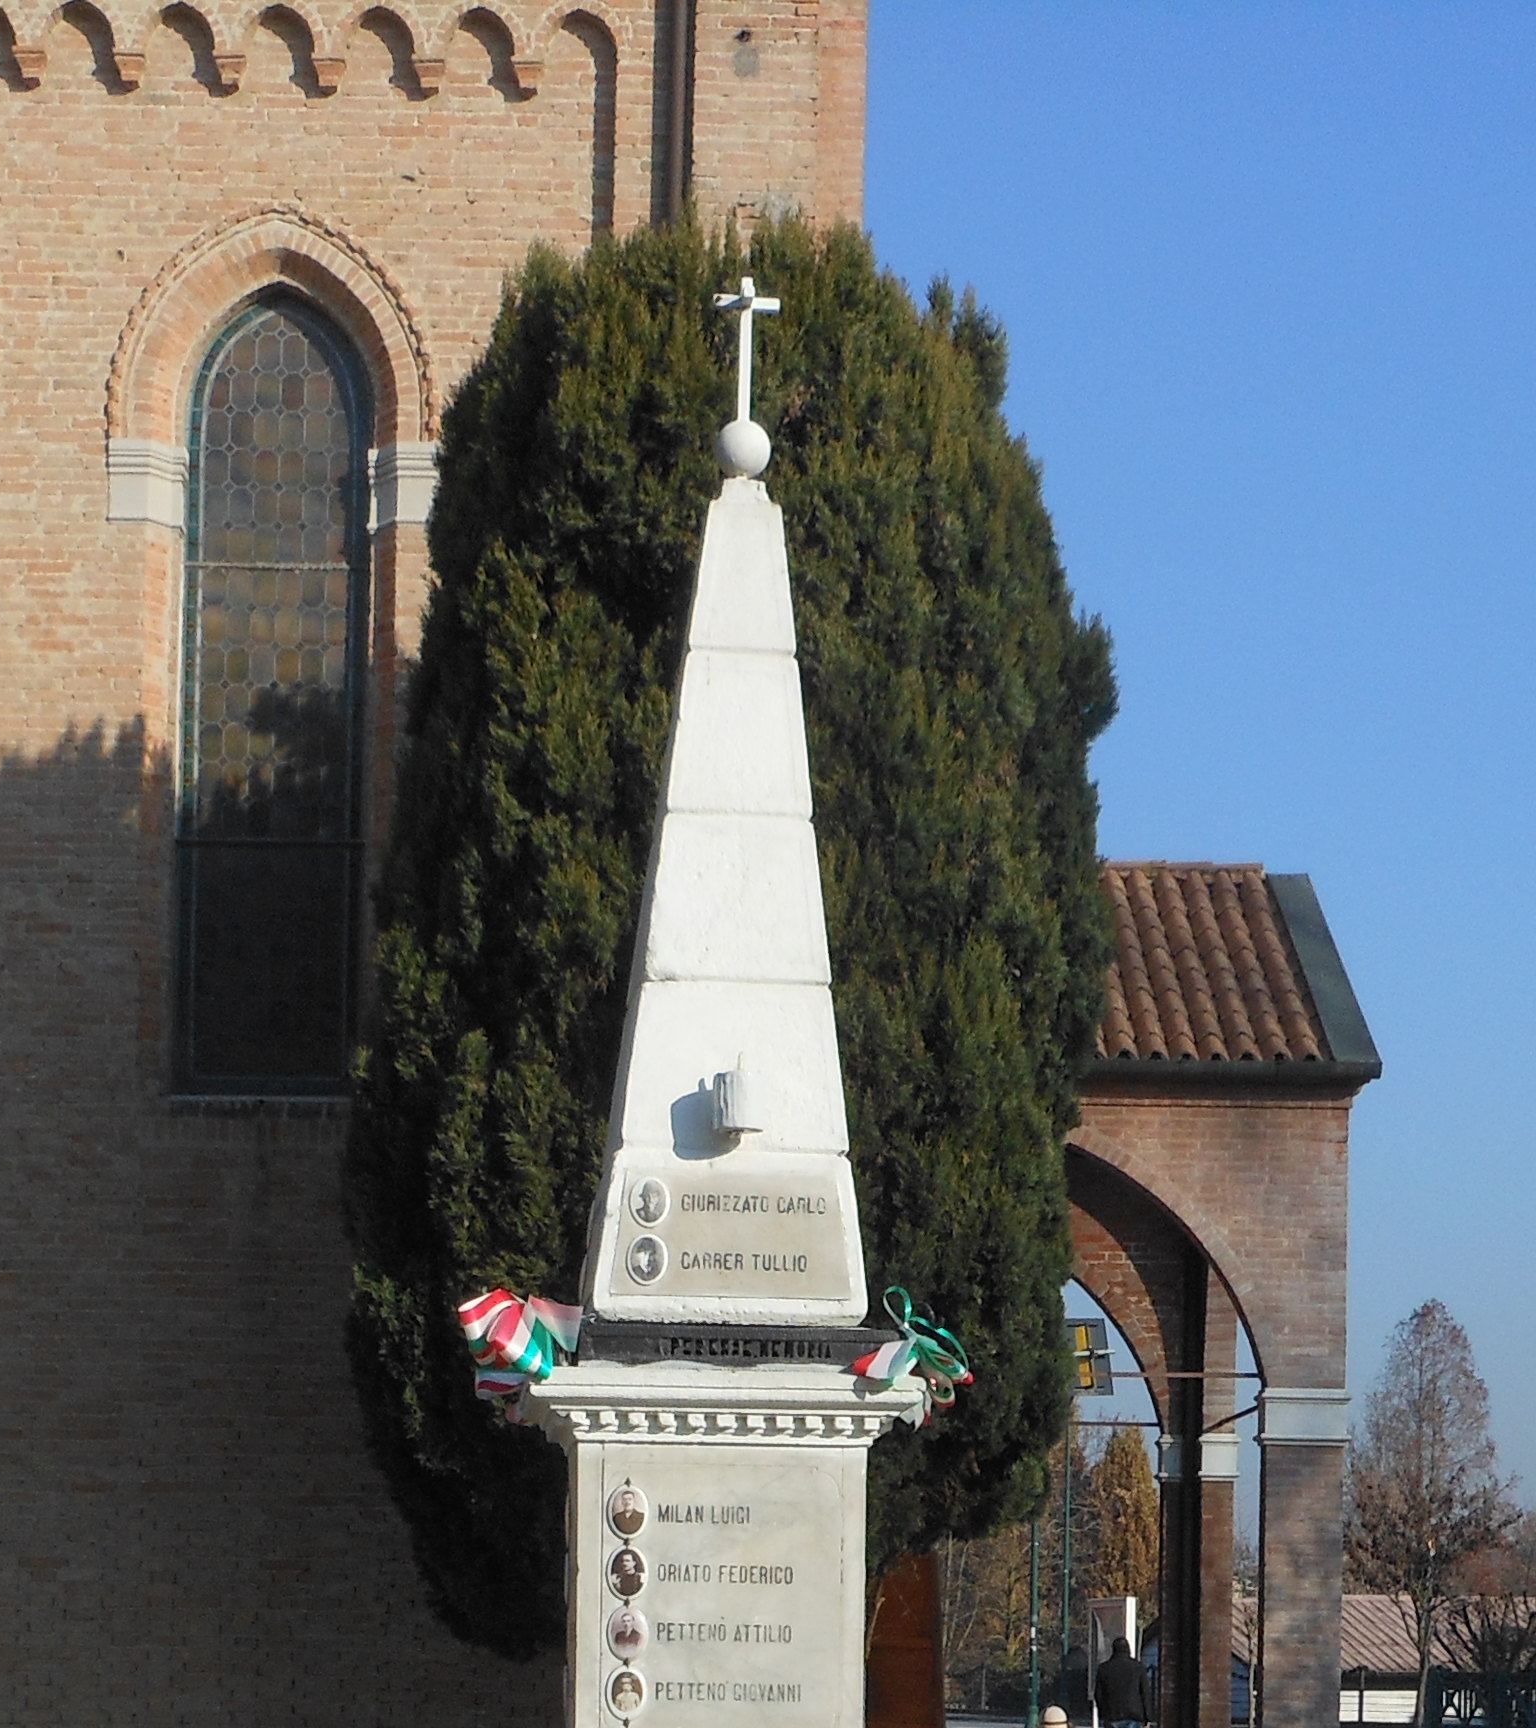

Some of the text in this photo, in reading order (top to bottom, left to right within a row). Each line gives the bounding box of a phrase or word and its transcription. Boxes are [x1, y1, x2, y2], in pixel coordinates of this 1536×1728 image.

[777, 1195, 826, 1215] CARLO
[680, 1251, 808, 1273] CARRER TULLIO
[657, 1504, 750, 1524] MILAN LUIGI
[657, 1564, 794, 1585] ORIATO FEDERICO
[733, 1625, 793, 1643] ATTILIO
[733, 1684, 801, 1702] GIOVANNI
